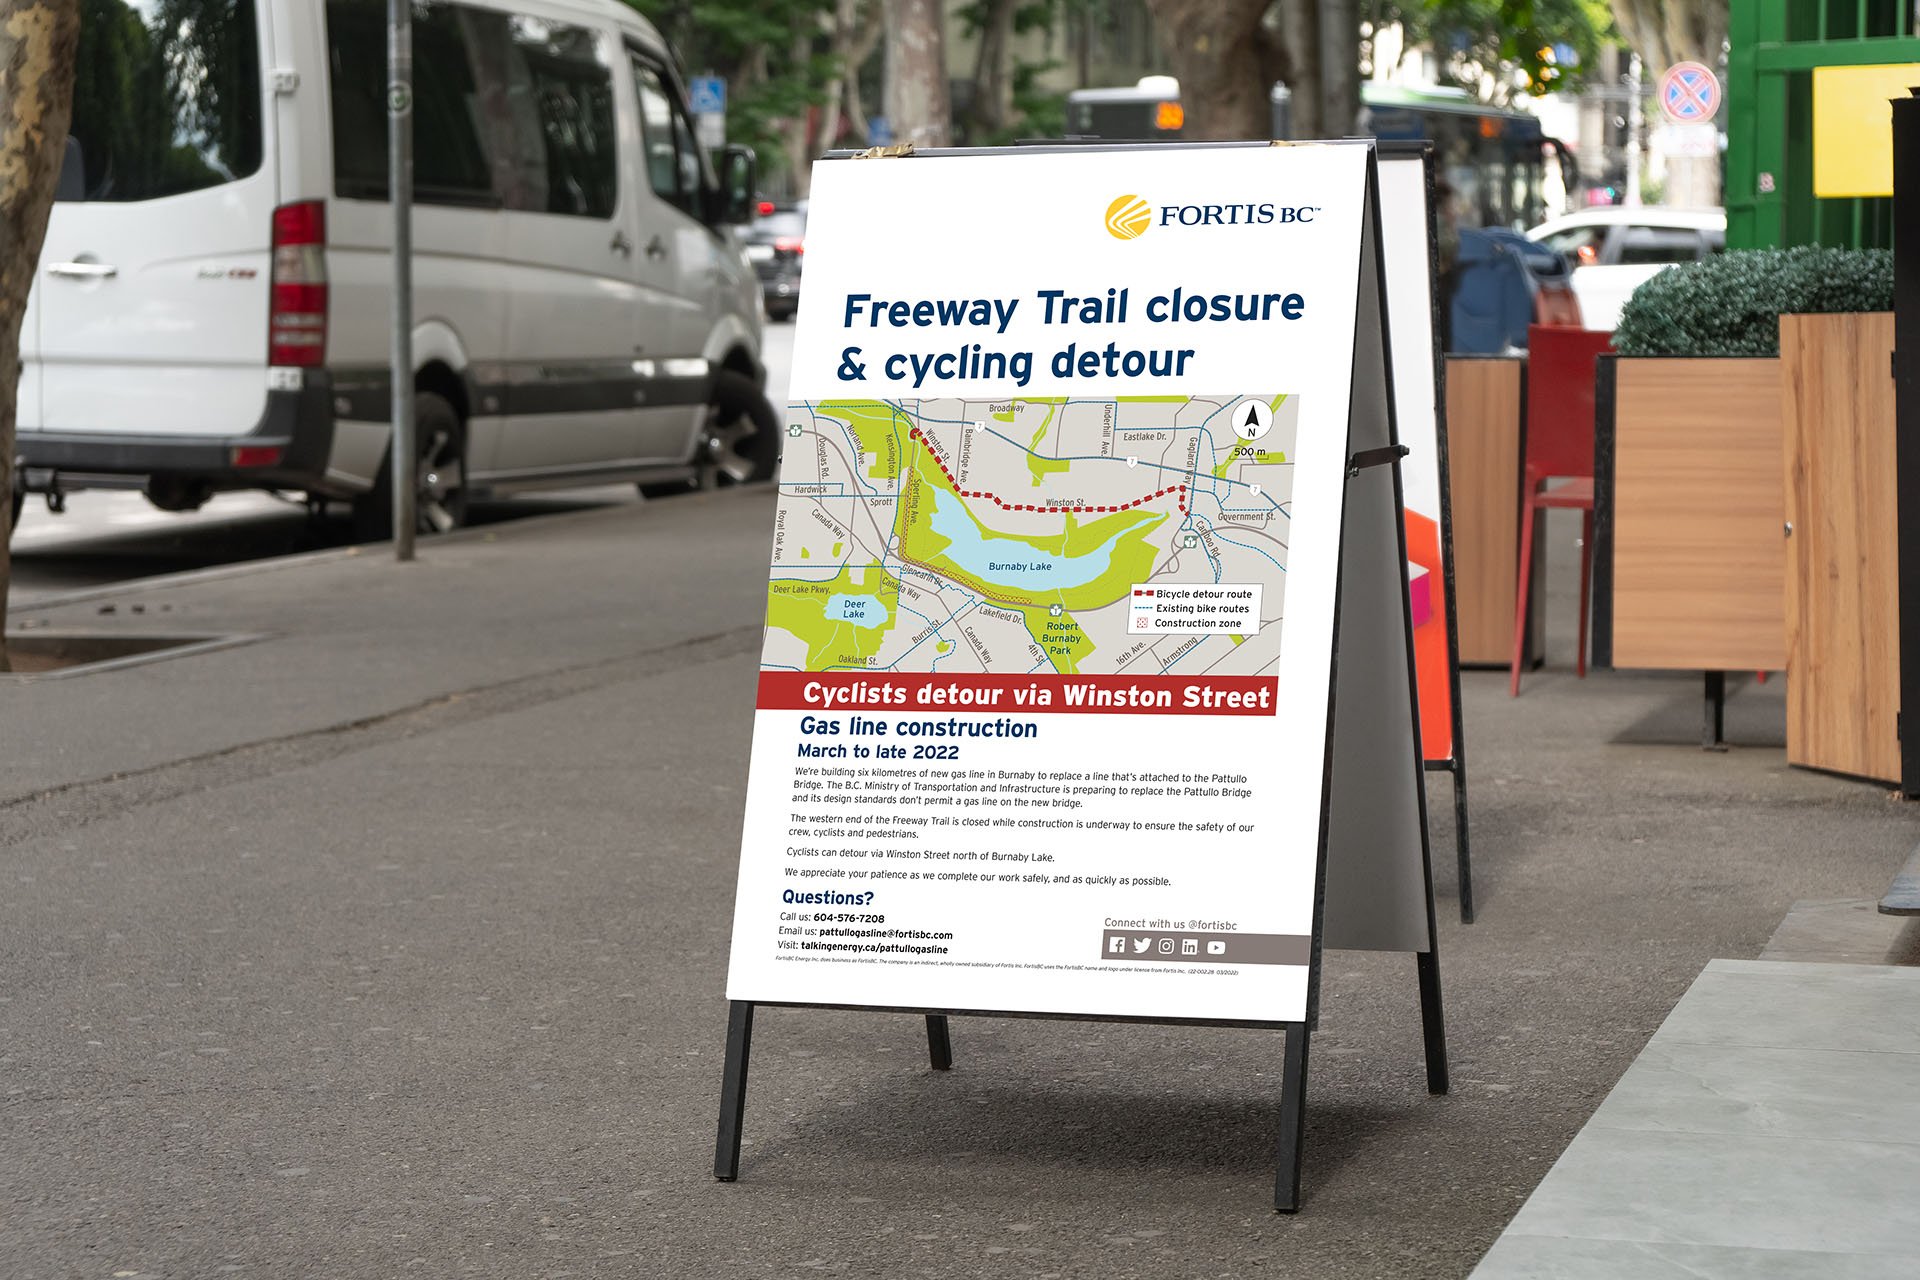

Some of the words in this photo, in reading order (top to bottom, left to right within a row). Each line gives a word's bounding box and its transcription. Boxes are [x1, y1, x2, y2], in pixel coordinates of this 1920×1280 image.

[1158, 203, 1274, 226] FORTIS
[843, 293, 1020, 334] Freeway
[1036, 287, 1129, 324] Trail
[1145, 286, 1305, 323] closure
[836, 346, 867, 381] &
[884, 343, 1033, 389] cycling
[1051, 341, 1195, 378] detour
[989, 403, 1025, 413] Broadway
[1104, 404, 1114, 438] Underhill
[1123, 432, 1154, 442] Eastlake
[1156, 432, 1167, 441] Dr.
[926, 428, 945, 455] Winston
[942, 452, 951, 464] St.
[961, 428, 973, 468] Bainbridge
[1101, 442, 1110, 457] Ave.
[1234, 448, 1258, 457] 500
[1258, 449, 1266, 457] m
[960, 469, 969, 485] Ave.
[794, 486, 828, 494] Hardwick
[870, 497, 893, 507] Sprott
[1046, 499, 1074, 507] Winston
[1076, 499, 1086, 507] St.
[811, 508, 833, 529] Canada
[832, 525, 846, 540] Way
[1218, 513, 1264, 522] Government
[1266, 513, 1276, 521] St.
[989, 562, 1028, 573] Burnaby
[1030, 562, 1052, 571] Lake
[774, 585, 790, 593] Deer
[811, 586, 831, 595] Pkwy.
[1156, 589, 1190, 600] Bicycle
[1192, 589, 1224, 599] detour
[1226, 589, 1252, 599] route
[845, 600, 866, 609] Deer
[1156, 603, 1194, 615] Existing
[1196, 603, 1217, 613] bike
[1218, 604, 1249, 613] routes
[844, 610, 865, 619] Lake
[979, 606, 1011, 621] Lakefield
[1011, 615, 1023, 624] Dr.
[1047, 622, 1079, 631] Robert
[1154, 618, 1216, 628] Construction
[1218, 620, 1242, 628] zone
[1042, 634, 1082, 644] Burnaby
[1050, 646, 1072, 655] Park
[1116, 652, 1133, 666] 16th
[1132, 641, 1147, 657] Ave.
[1162, 636, 1198, 666] Armstrong
[838, 655, 865, 664] Oakland
[867, 657, 878, 666] St.
[803, 681, 907, 706] Cyclists
[916, 682, 1004, 705] detour
[1012, 682, 1052, 706] via
[1063, 683, 1172, 707] Winston
[1182, 685, 1270, 708] Street
[800, 715, 840, 735] Gas
[849, 715, 888, 736] line
[895, 717, 1037, 738] construction
[797, 743, 847, 758] March
[853, 743, 870, 758] to
[875, 744, 907, 759] late
[912, 744, 959, 760] 2022
[821, 767, 855, 778] building
[857, 767, 869, 777] six
[871, 767, 917, 778] kilometres
[918, 768, 929, 778] of
[930, 770, 949, 778] new
[950, 770, 966, 780] gas
[968, 769, 985, 779] line
[987, 769, 996, 779] in
[998, 770, 1035, 781] Burnaby
[1037, 771, 1047, 780] to
[1049, 771, 1082, 781] replace
[1084, 773, 1090, 781] a
[1092, 771, 1109, 781] line
[1139, 772, 1180, 782] attached
[1181, 773, 1192, 783] to
[1194, 773, 1209, 783] the
[1211, 773, 1247, 784] Pattullo
[793, 779, 824, 791] Bridge.
[826, 780, 843, 790] The
[844, 780, 862, 790] B.C.
[864, 781, 900, 792] Ministry
[901, 781, 911, 791] of
[913, 782, 978, 793] Transportation
[979, 783, 997, 792] and
[999, 783, 1061, 794] Infrastructure
[1062, 784, 1070, 794] is
[1072, 785, 1116, 797] preparing
[1118, 785, 1129, 795] to
[1130, 786, 1164, 797] replace
[1166, 786, 1182, 796] the
[1183, 786, 1220, 797] Pattullo
[1221, 787, 1252, 799] Bridge
[791, 793, 808, 803] and
[810, 793, 821, 803] its
[823, 793, 852, 805] design
[854, 794, 897, 804] standards
[923, 795, 953, 806] permit
[963, 798, 979, 808] gas
[981, 796, 998, 806] line
[999, 798, 1012, 806] on
[1014, 797, 1029, 807] the
[1031, 799, 1050, 807] new
[1052, 798, 1083, 809] bridge.
[786, 846, 819, 857] Cyclists
[821, 849, 837, 857] can
[839, 848, 868, 858] detour
[870, 848, 884, 858] via
[886, 849, 921, 859] Winston
[923, 849, 950, 860] Street
[952, 851, 978, 860] north
[979, 851, 989, 861] of
[991, 851, 1029, 863] Burnaby
[1031, 852, 1055, 862] Lake.
[784, 867, 798, 877] We
[799, 868, 846, 878] appreciate
[848, 870, 868, 879] your
[870, 869, 908, 880] patience
[909, 871, 920, 880] as
[922, 872, 935, 880] we
[937, 871, 978, 882] complete
[979, 873, 996, 882] our
[998, 873, 1020, 882] work
[1022, 873, 1050, 884] safely,
[1052, 874, 1070, 883] and
[1072, 876, 1083, 884] as
[1084, 874, 1117, 887] quickly
[1118, 877, 1130, 885] as
[1131, 876, 1171, 887] possible.
[782, 888, 874, 906] Questions?
[779, 911, 796, 921] Call
[798, 914, 811, 922] us:
[813, 912, 885, 924] 604-576-7208
[1104, 917, 1146, 928] Connect
[1148, 918, 1171, 929] with
[1173, 921, 1185, 929] us
[1188, 919, 1237, 931] @fortisbc
[778, 925, 802, 935] Email
[804, 928, 817, 936] us:
[819, 927, 953, 940] pattullogasline@fortisbc.com
[777, 940, 799, 949] Visit:
[800, 941, 948, 955] talkingenergy.ca/pattullogasline
